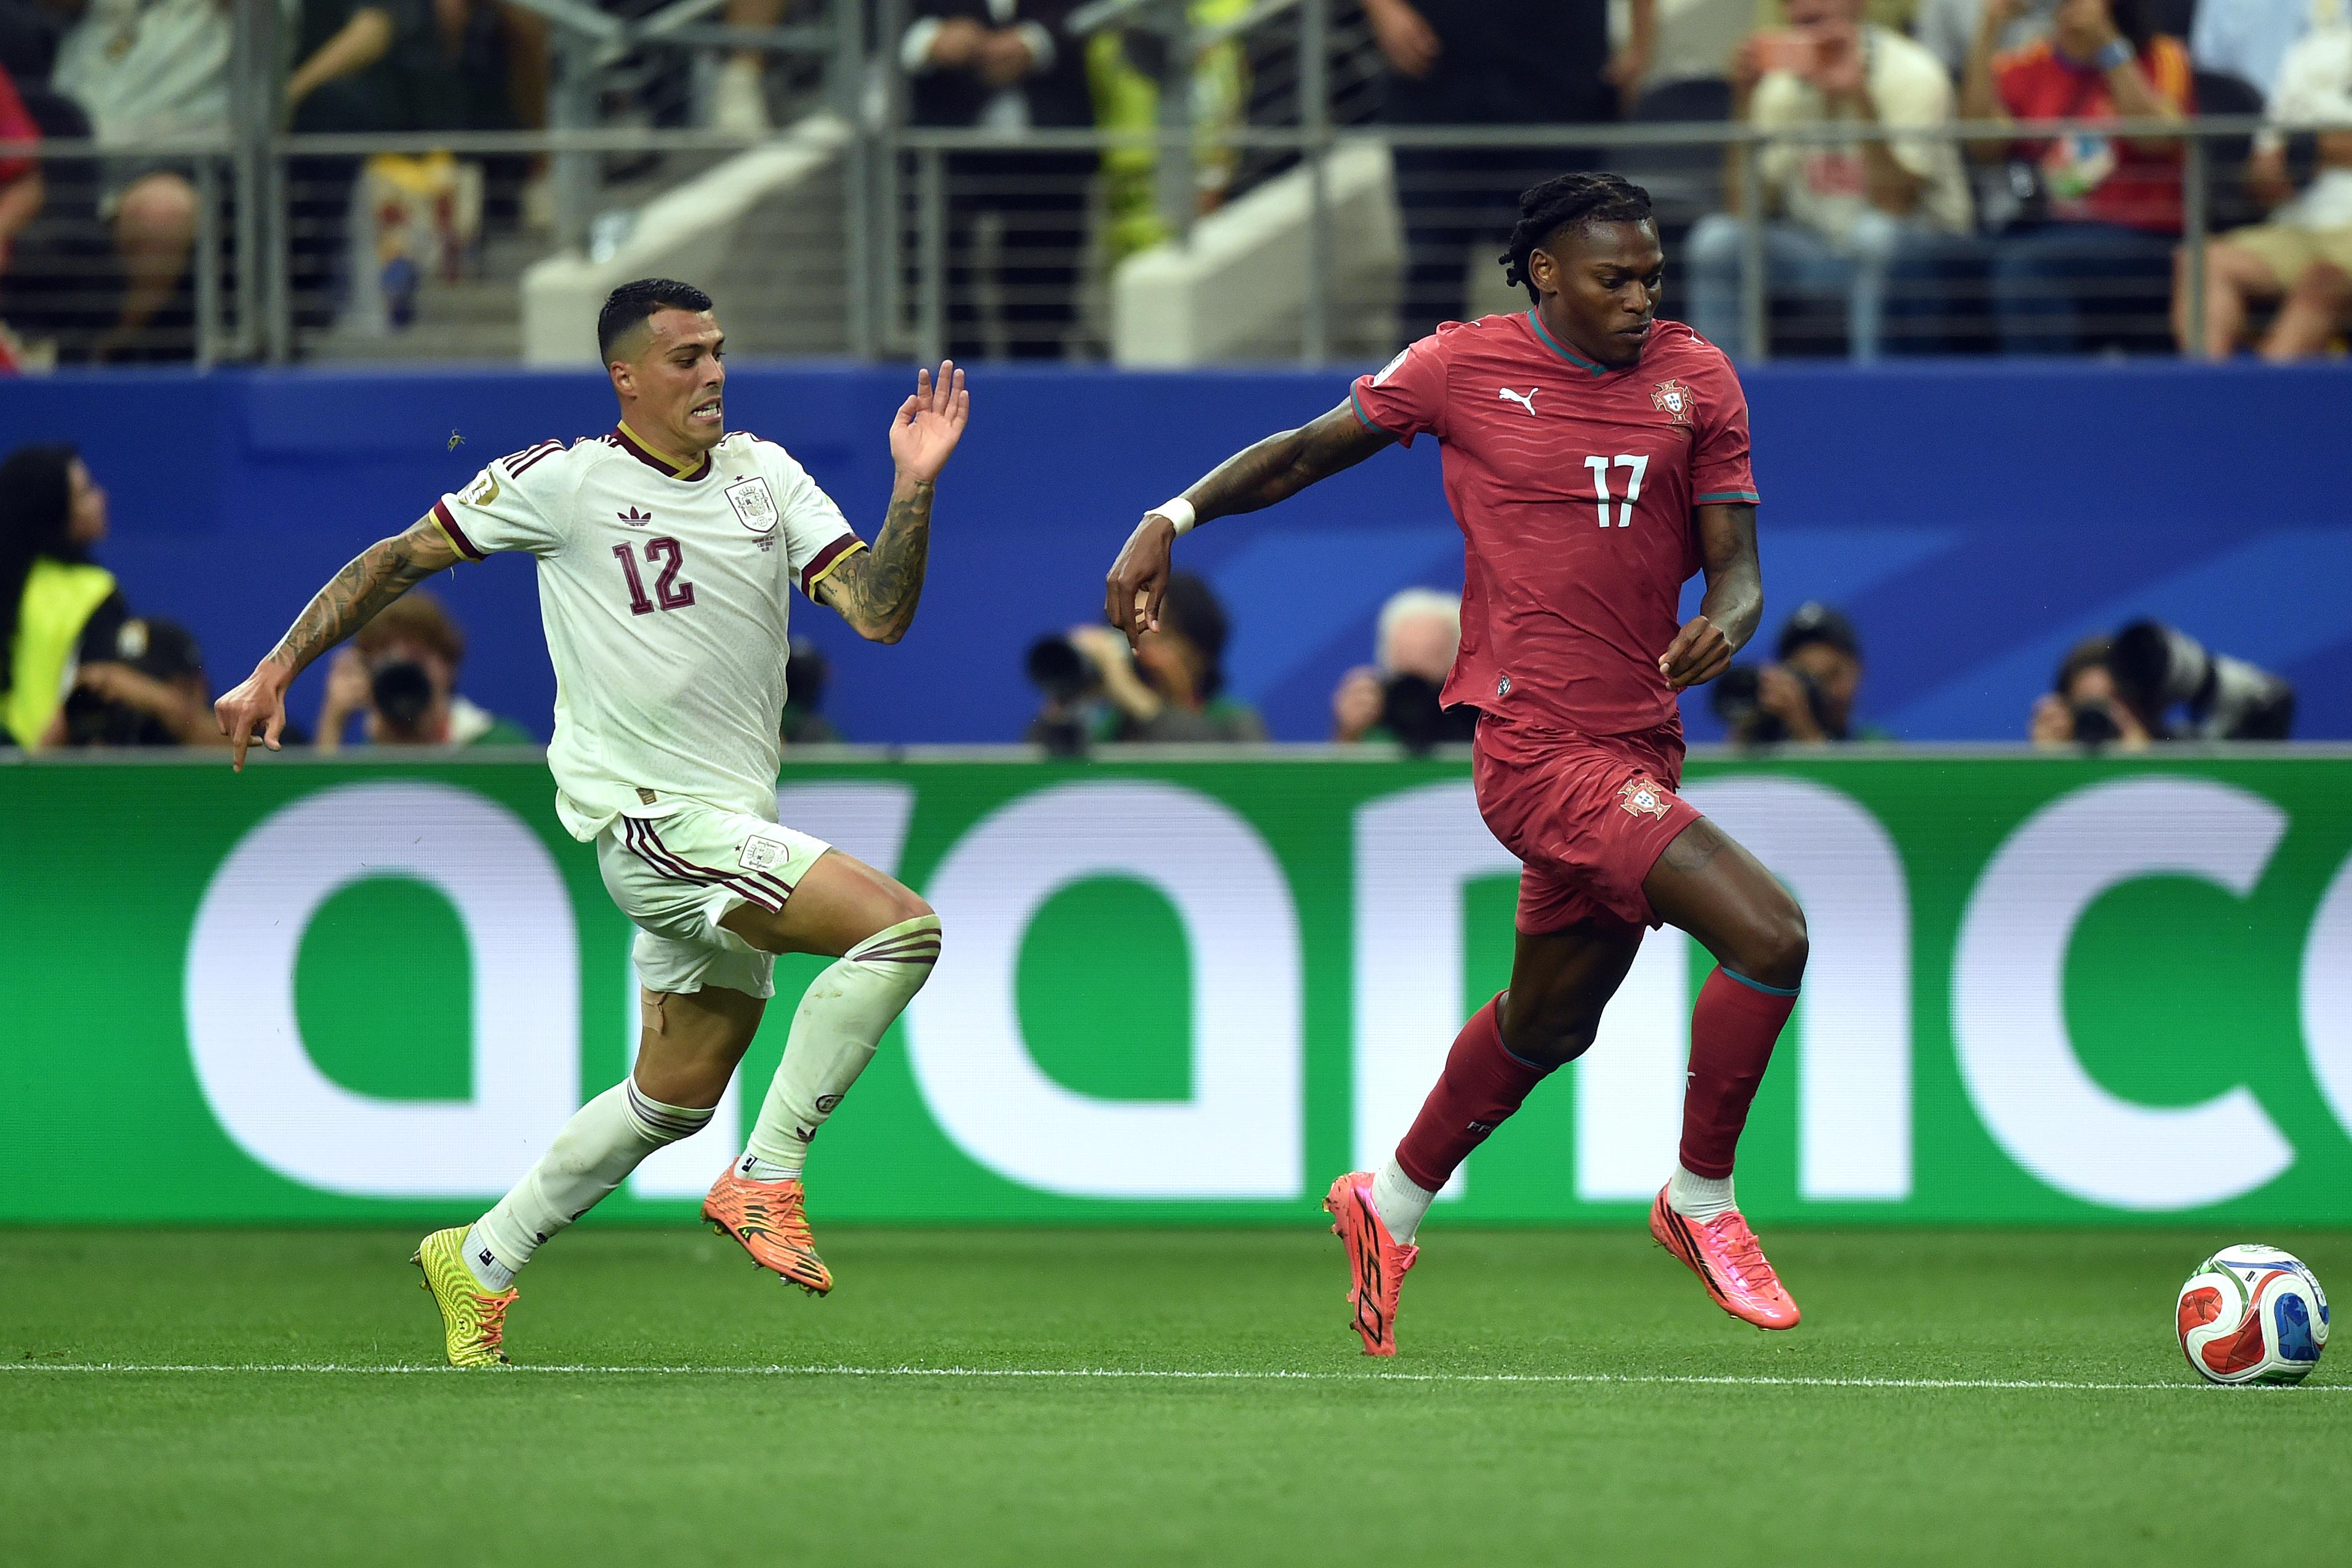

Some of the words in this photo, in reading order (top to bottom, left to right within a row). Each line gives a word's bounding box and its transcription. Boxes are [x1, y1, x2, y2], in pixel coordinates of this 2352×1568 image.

[1584, 454, 1649, 527] 17
[612, 537, 695, 616] 12
[183, 777, 2352, 1210] aamc
